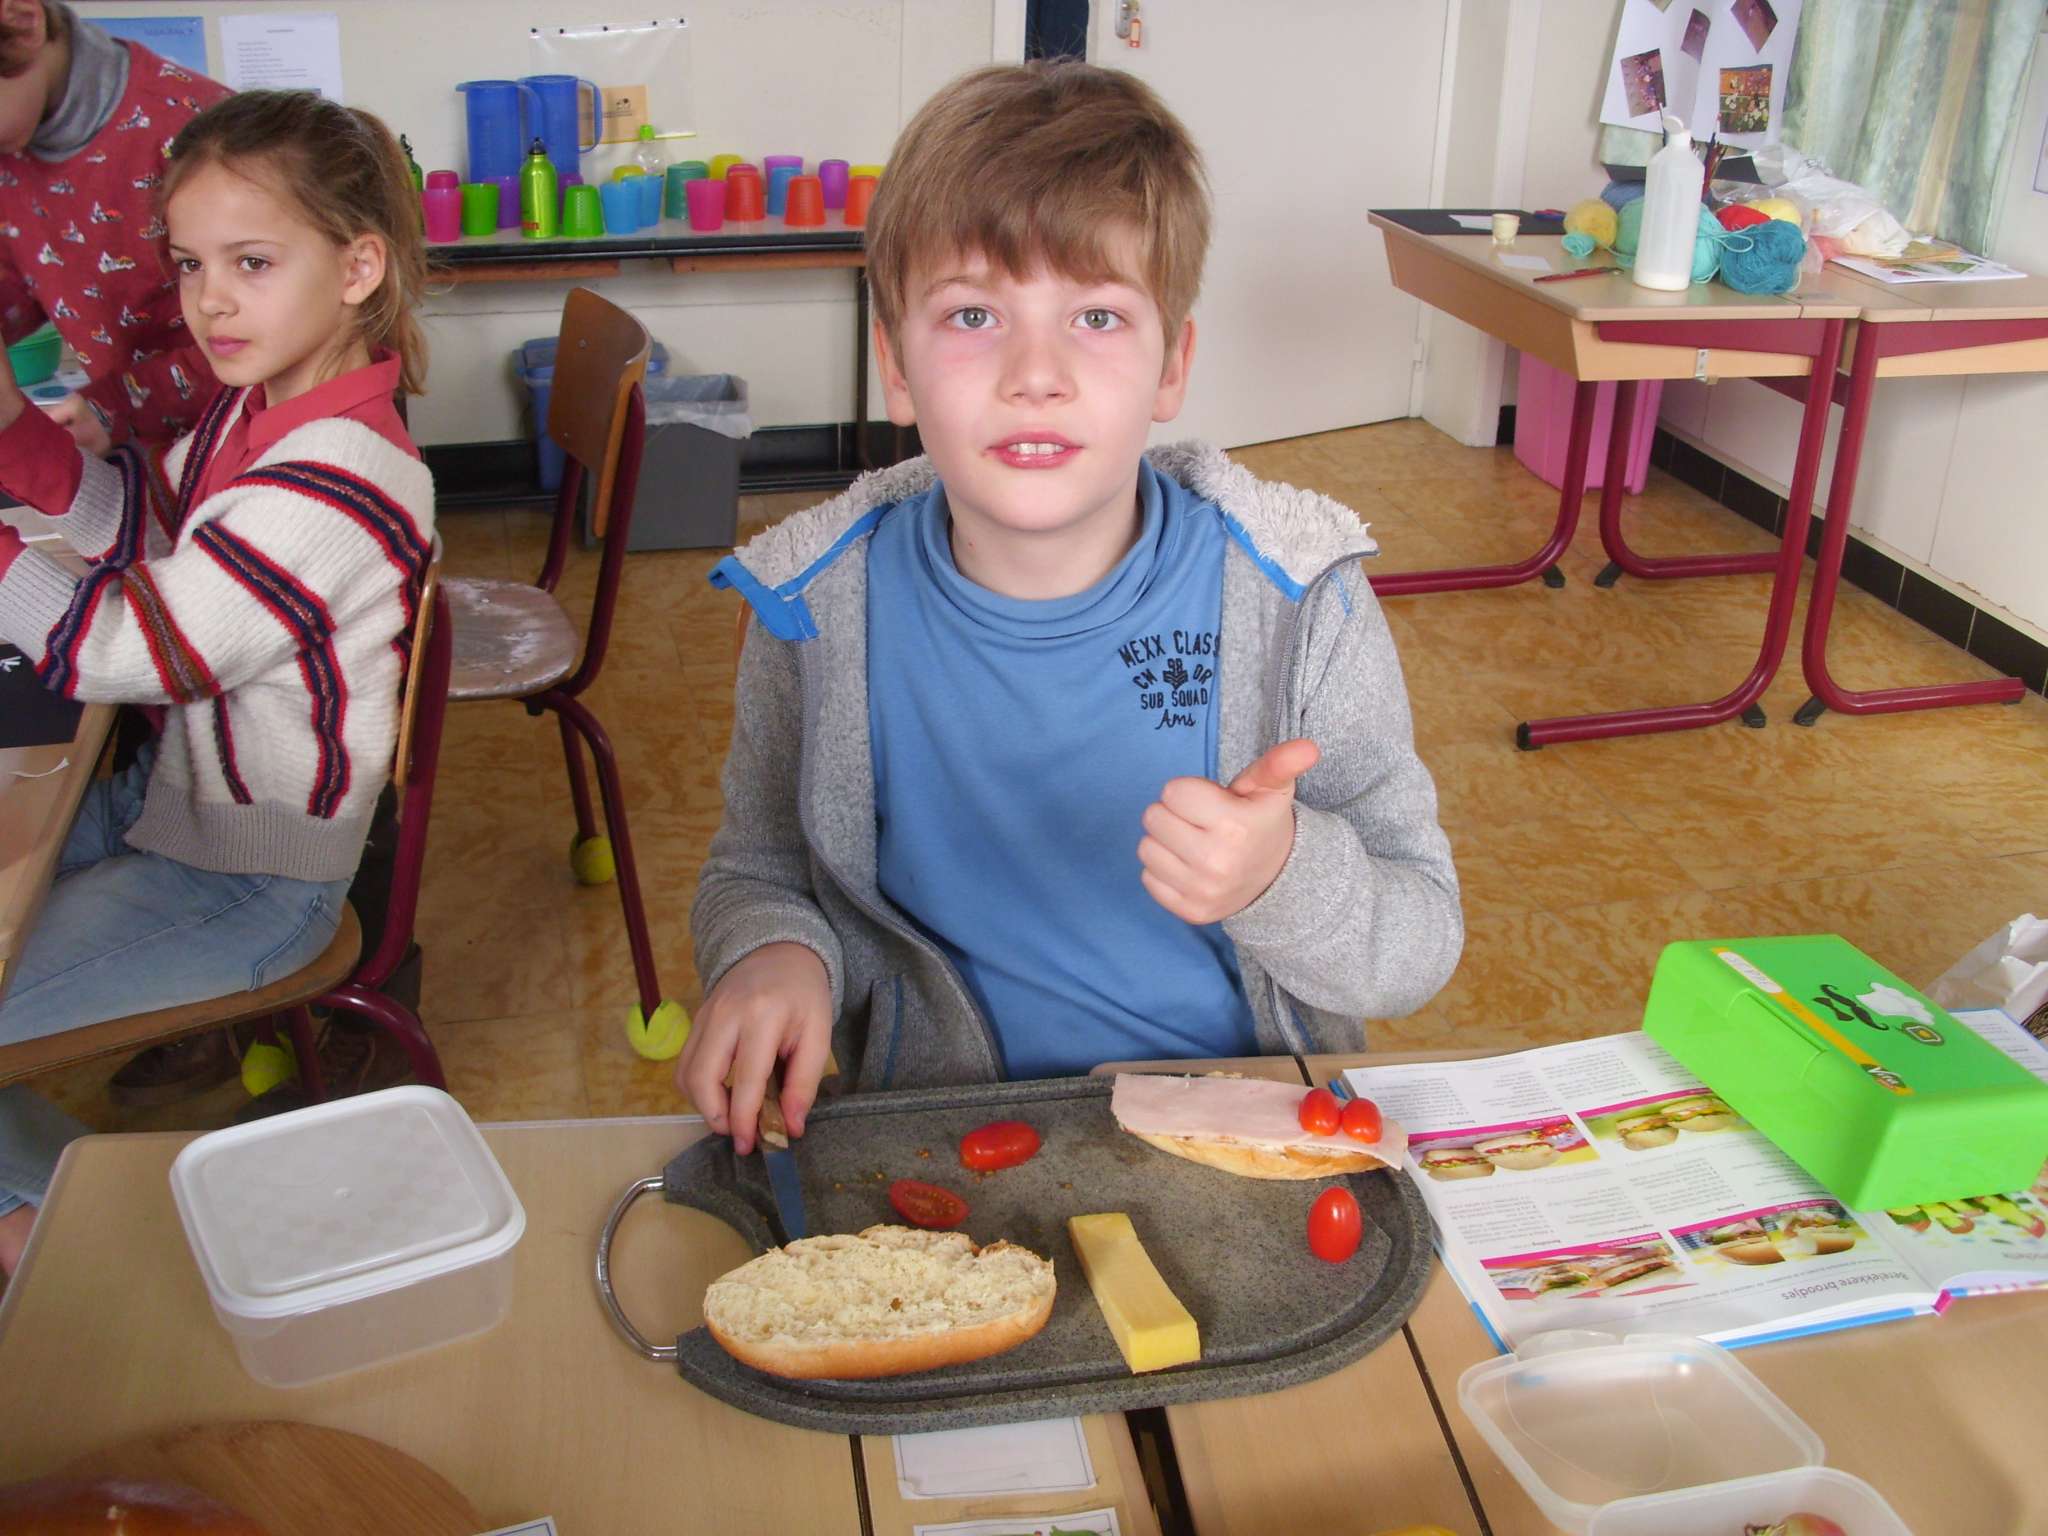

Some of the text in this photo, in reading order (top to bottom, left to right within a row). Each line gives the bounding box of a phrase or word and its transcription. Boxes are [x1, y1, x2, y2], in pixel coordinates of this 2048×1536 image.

[1117, 634, 1166, 668] MEXX
[1140, 687, 1208, 710] SUB SQUAD
[1781, 1280, 1840, 1300] broodjes
